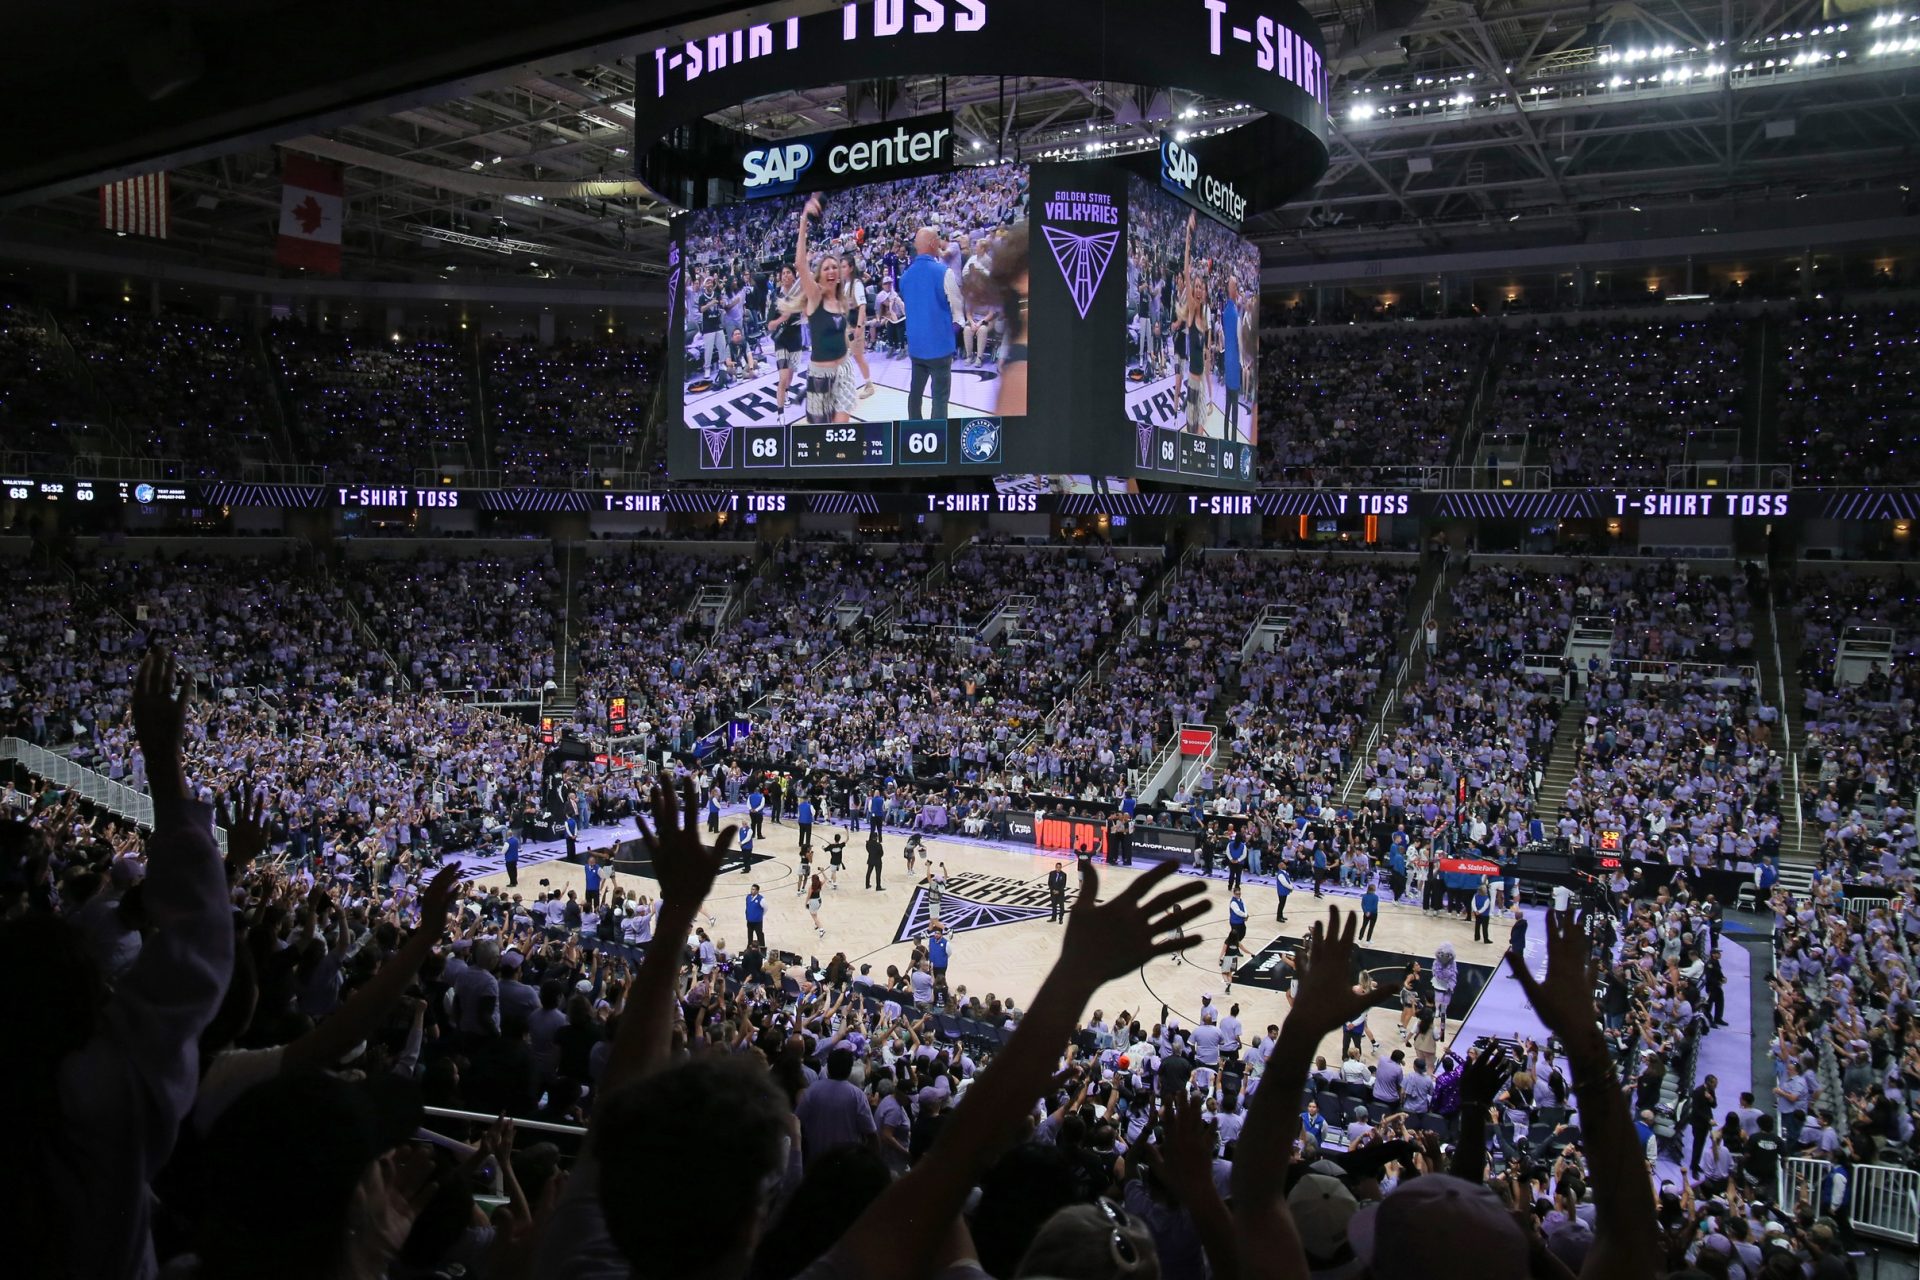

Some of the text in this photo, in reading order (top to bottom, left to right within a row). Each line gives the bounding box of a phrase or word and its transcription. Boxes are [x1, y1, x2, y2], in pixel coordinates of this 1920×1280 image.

[1204, 0, 1322, 105] T-SHIRT
[742, 126, 949, 187] SAP center
[1168, 141, 1247, 222] SAP center
[1055, 191, 1111, 205] GOLDEN STATE
[1045, 202, 1118, 225] VALKYRIES
[825, 428, 857, 442] 5:32
[908, 432, 938, 454] 60
[752, 438, 778, 458] 68
[1161, 440, 1174, 461] 68
[1193, 440, 1206, 453] 5:32
[1223, 451, 1234, 469] 60
[9, 487, 28, 499] 68
[41, 483, 64, 493] 5:32
[76, 489, 94, 501] 60
[339, 488, 458, 507] T-SHIRT TOSS
[605, 494, 665, 512] T-SHIR
[747, 495, 786, 511] TOSS
[928, 494, 1037, 511] T-SHIRT TOSS
[1189, 495, 1257, 514] T-SHIR
[1359, 495, 1408, 514] TOSS
[1615, 494, 1788, 516] T-SHIRT TOSS
[609, 705, 625, 719] 24
[1014, 827, 1032, 835] APP
[1034, 816, 1071, 849] YOUR
[1162, 845, 1192, 853] UPDATES
[1602, 838, 1617, 849] 24
[957, 871, 1029, 887] GOLDEN
[1583, 914, 1593, 936] Google
